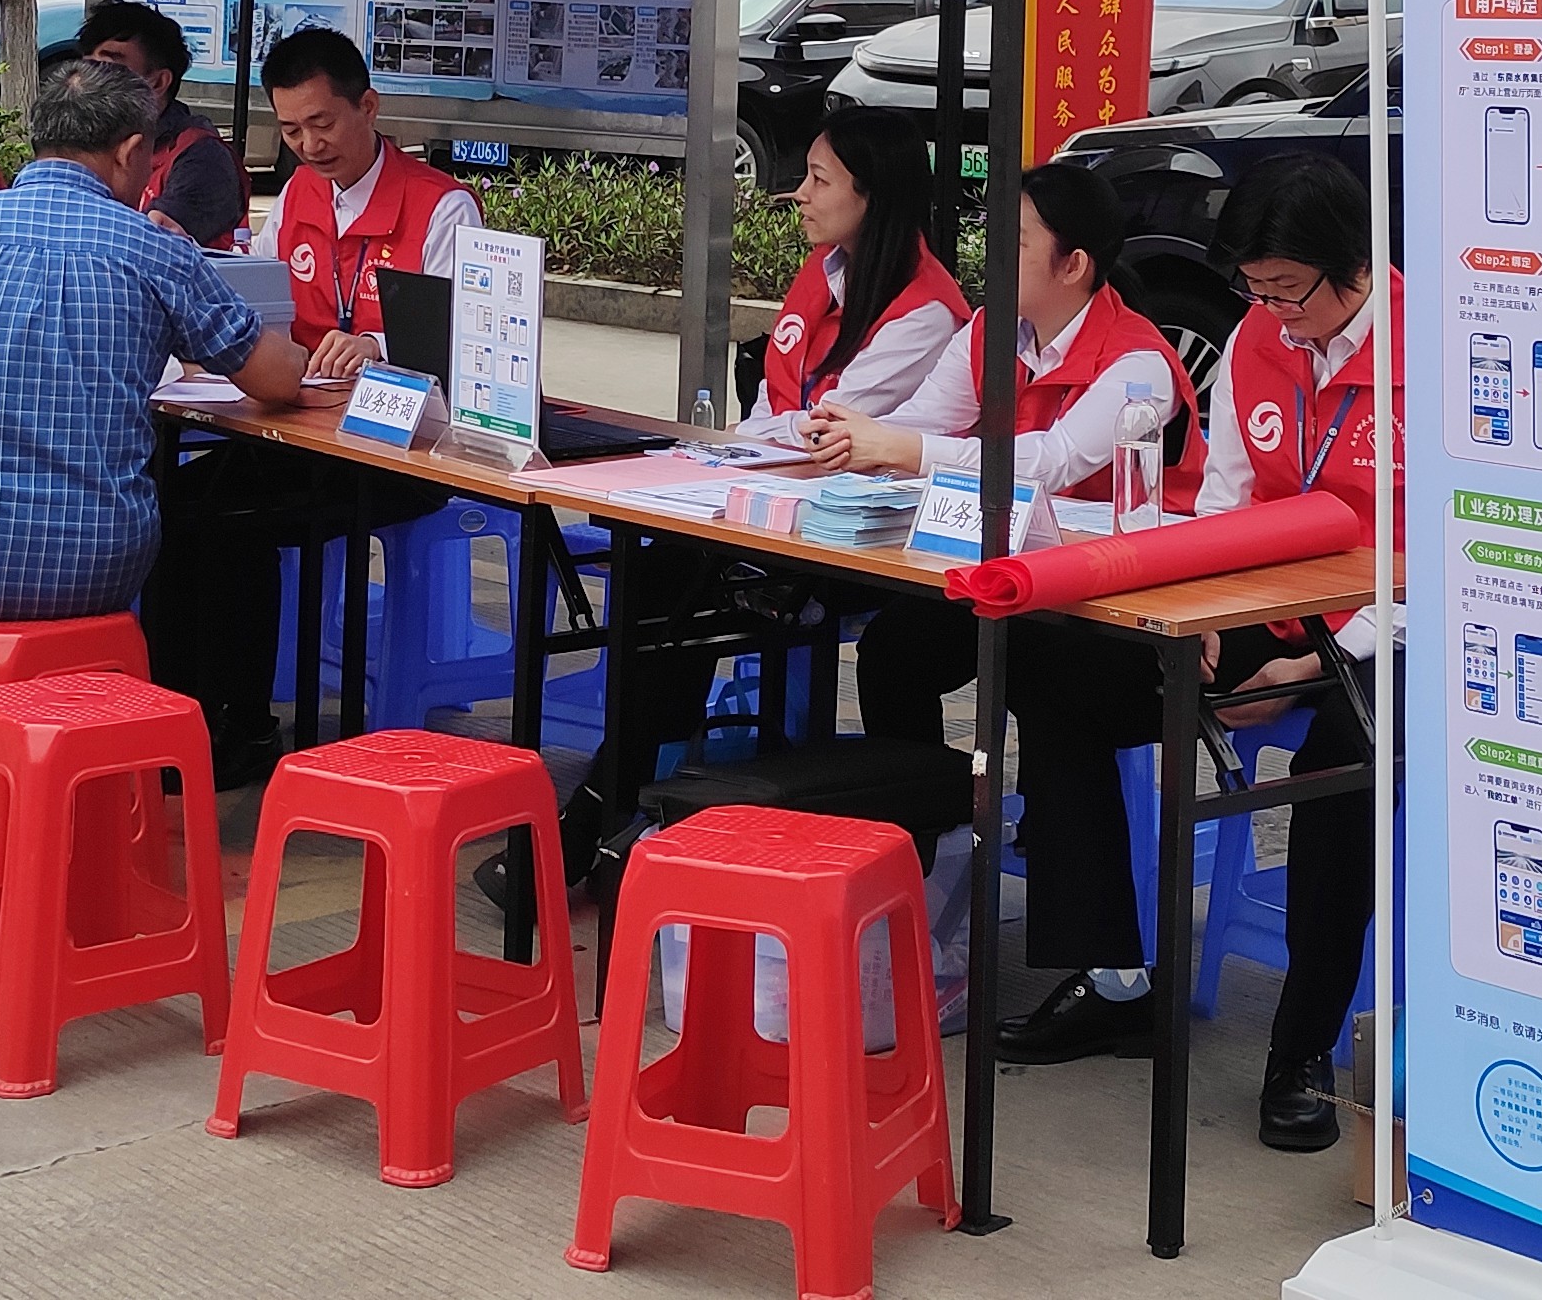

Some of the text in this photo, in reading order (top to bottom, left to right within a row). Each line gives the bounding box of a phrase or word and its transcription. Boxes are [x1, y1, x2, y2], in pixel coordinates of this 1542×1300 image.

[355, 386, 417, 421] 业务咨询
[927, 496, 1020, 538] 业务
